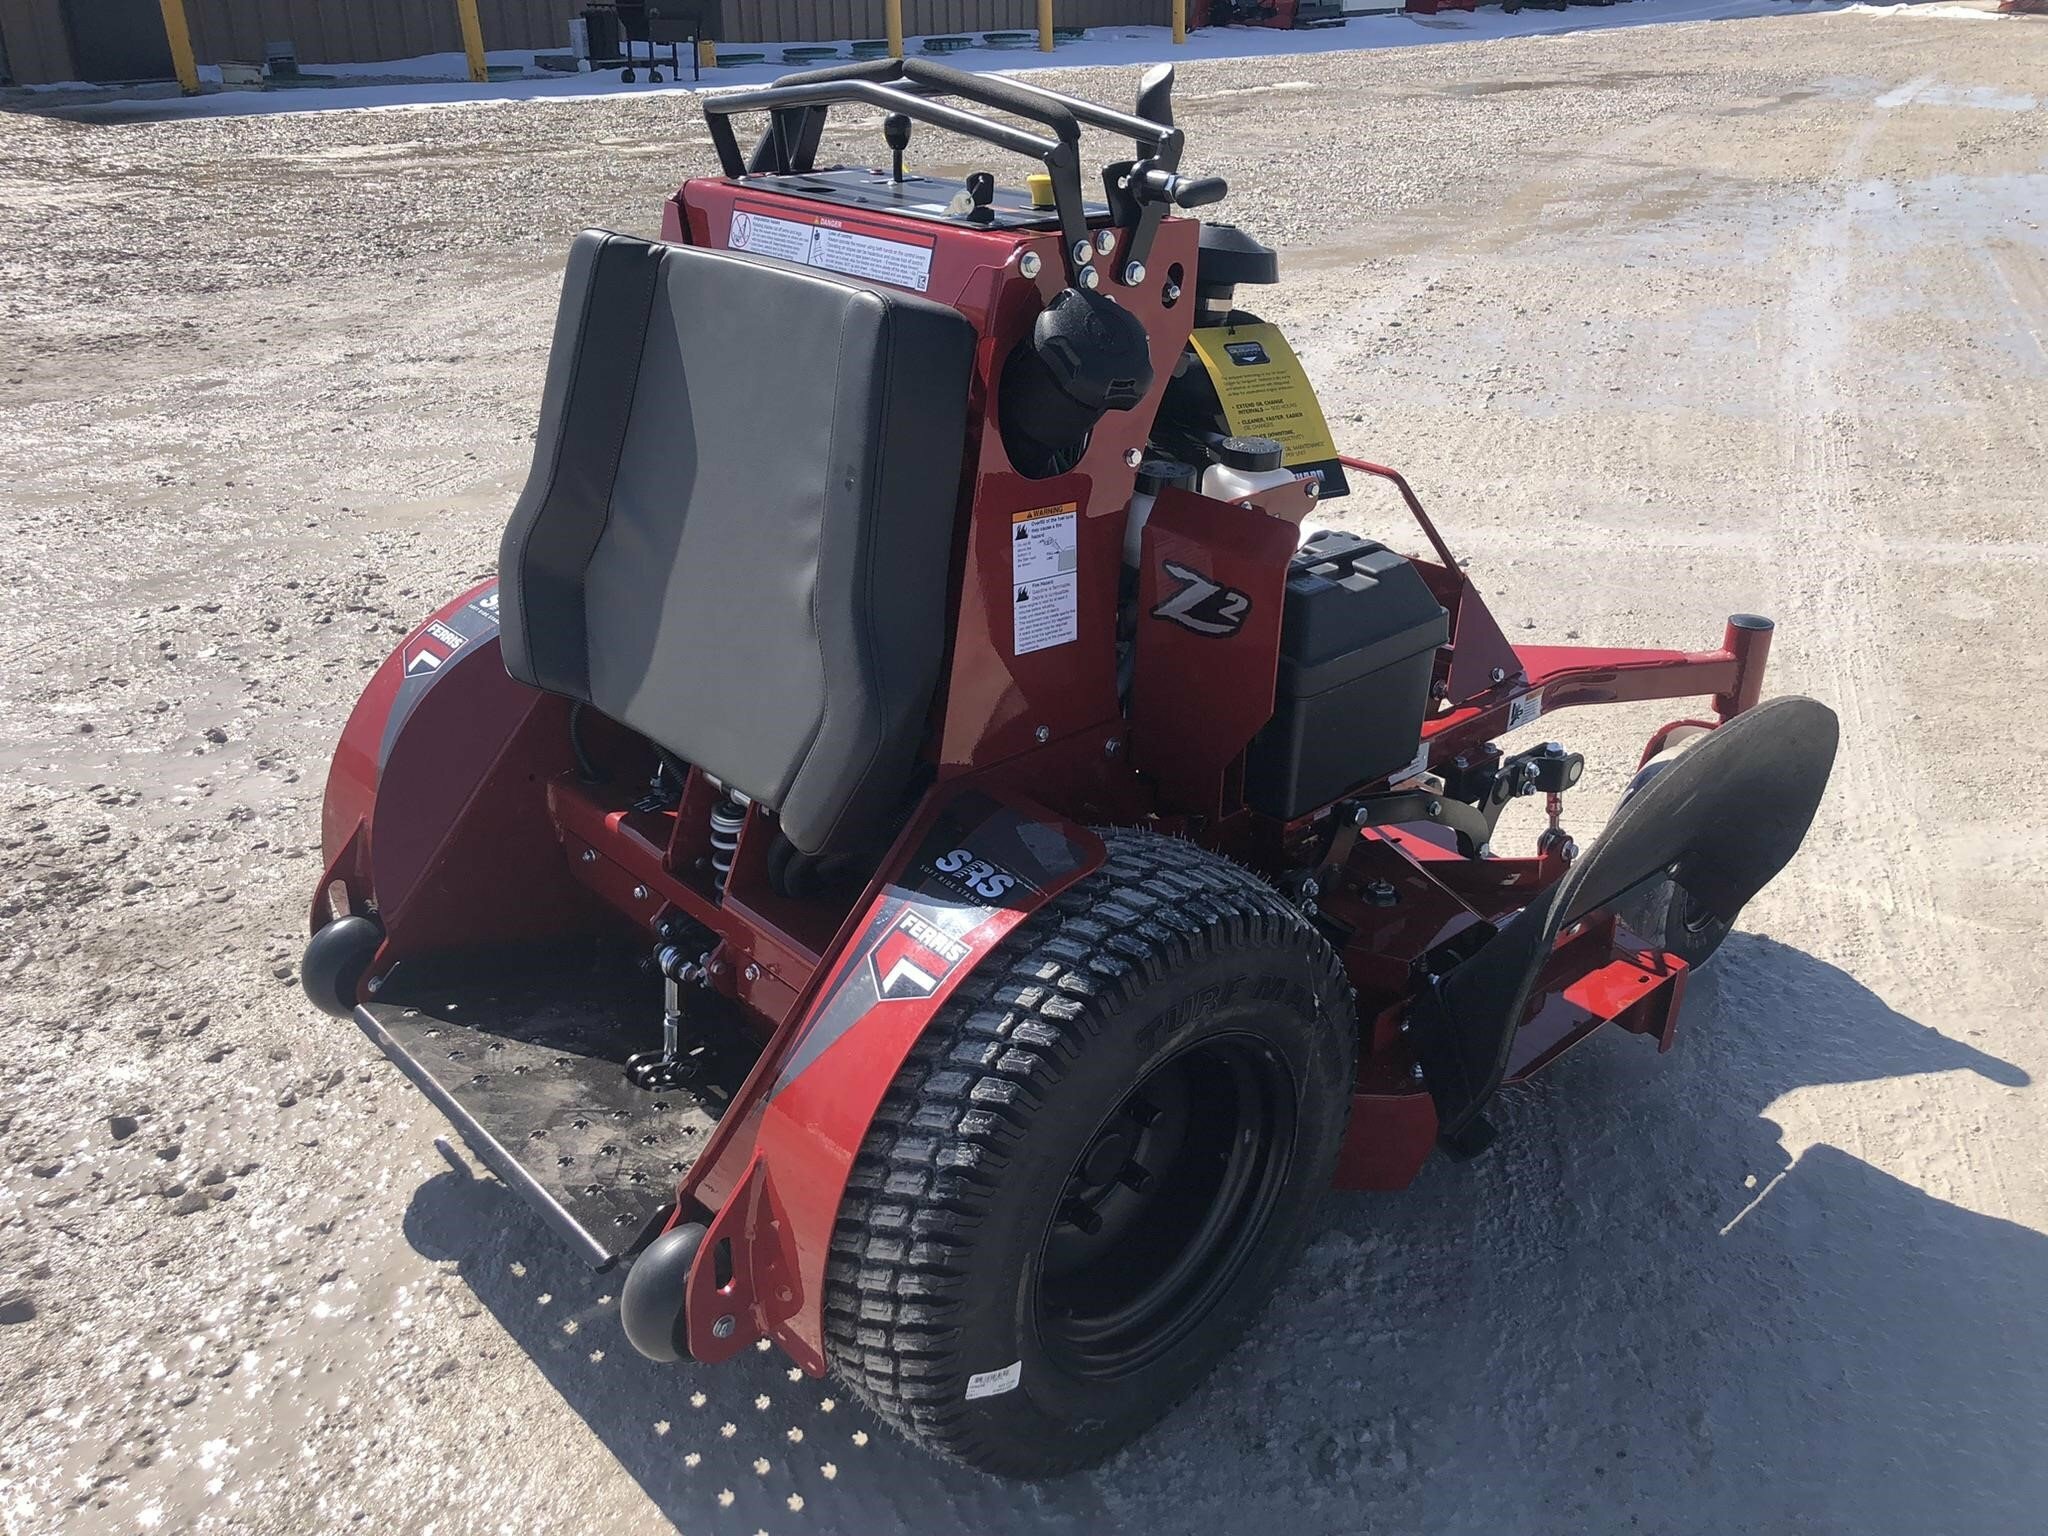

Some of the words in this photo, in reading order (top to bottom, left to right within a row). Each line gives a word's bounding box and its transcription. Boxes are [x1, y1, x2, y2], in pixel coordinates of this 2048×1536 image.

[820, 216, 843, 229] DANGER
[1033, 505, 1063, 517] WARNING
[427, 623, 463, 649] FERRIS
[935, 849, 1015, 898] SRS
[900, 914, 963, 962] FERRIS
